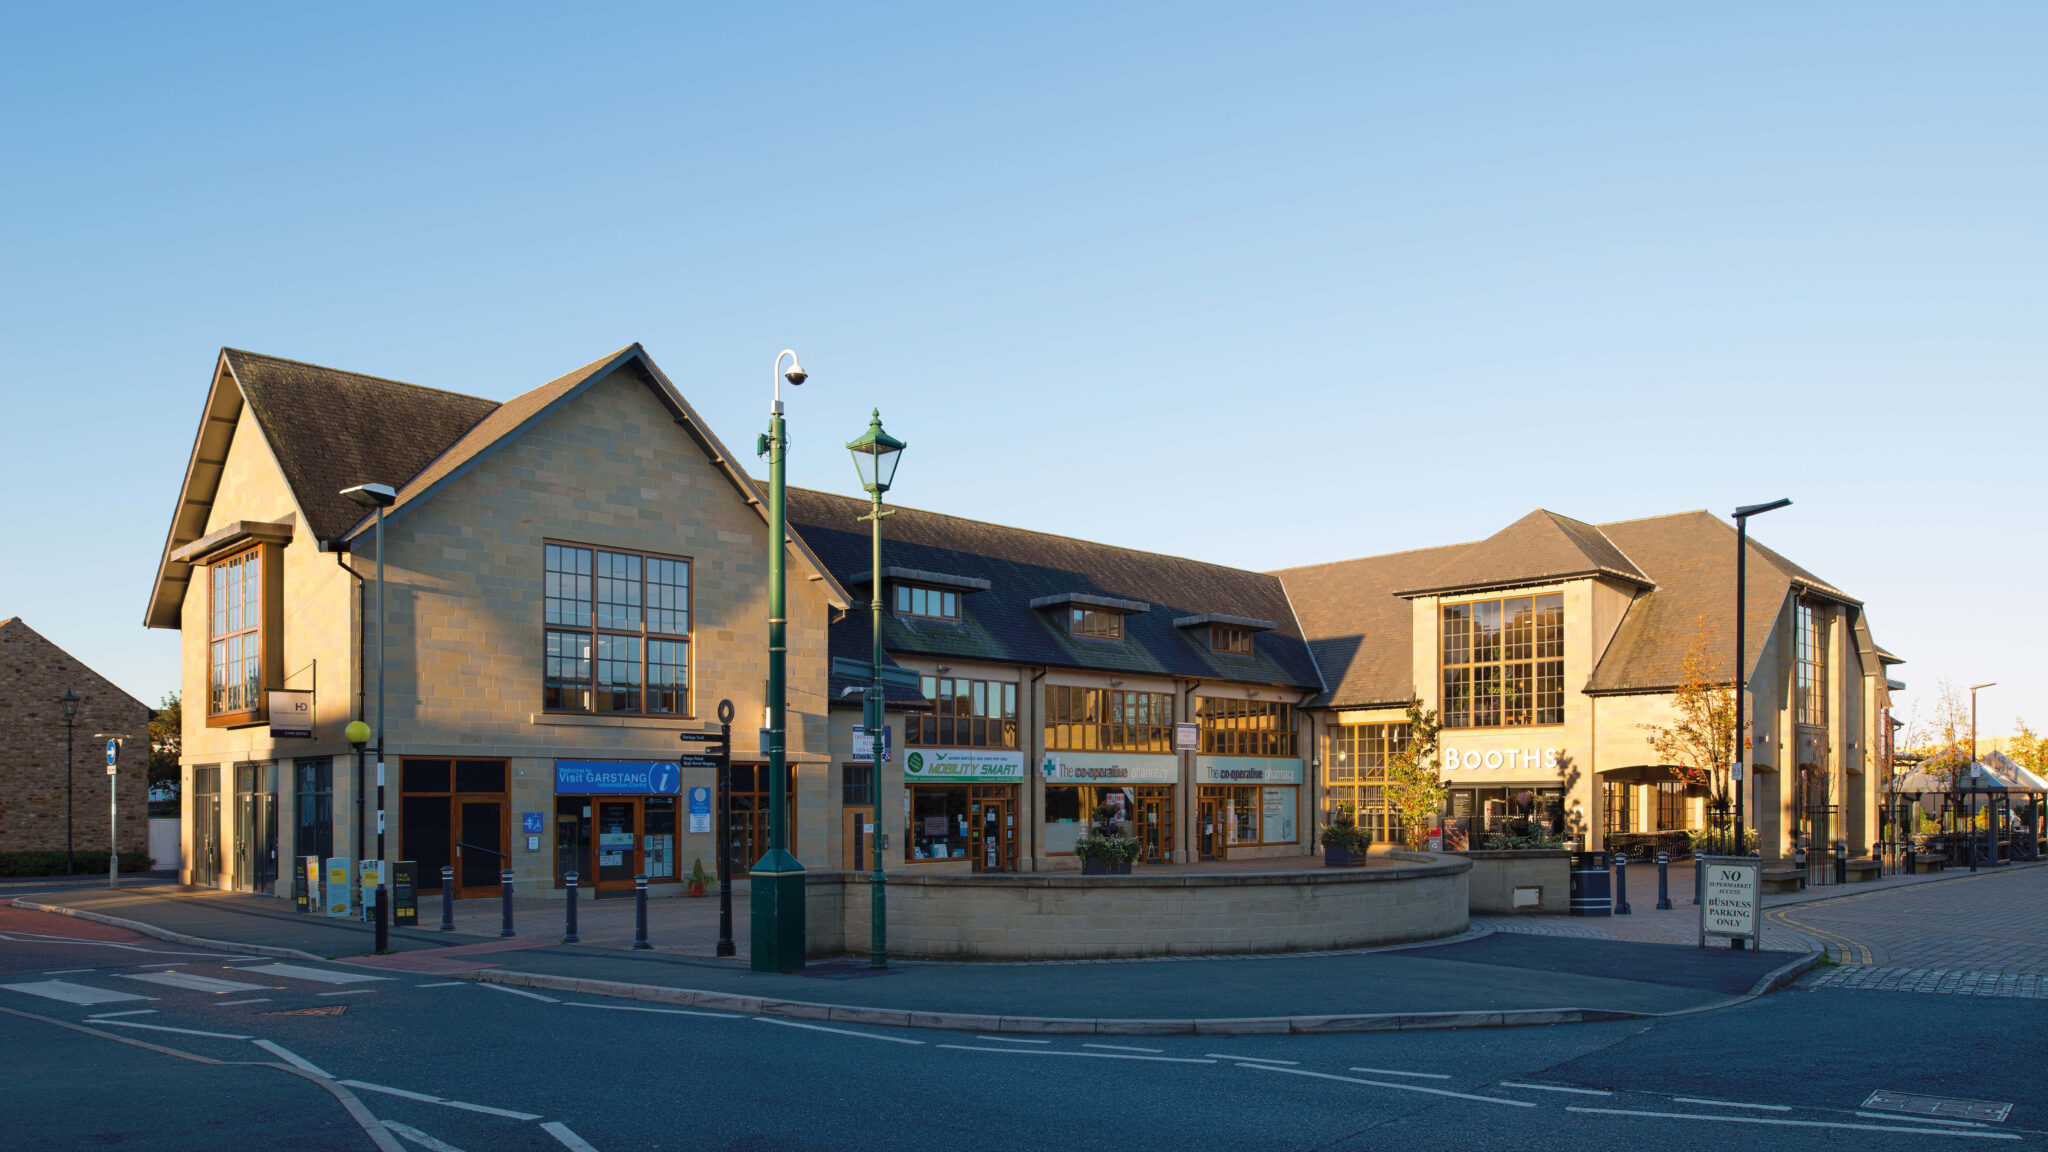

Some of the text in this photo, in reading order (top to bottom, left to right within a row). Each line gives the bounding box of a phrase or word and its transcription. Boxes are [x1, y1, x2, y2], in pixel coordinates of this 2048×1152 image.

[295, 702, 308, 711] HD
[1446, 747, 1558, 770] BOOTHS
[928, 763, 1018, 775] MOBILITY SMART
[1059, 764, 1168, 781] The co-operative pharmacy
[1206, 766, 1295, 782] The co-operative pharmacy
[559, 773, 647, 783] Visit GARSTANG
[1720, 870, 1741, 881] NO
[1709, 881, 1752, 889] SUPERMARKET
[1708, 898, 1752, 908] BUSINESS
[1709, 908, 1750, 918] PARKING
[1716, 918, 1742, 927] ONLY
